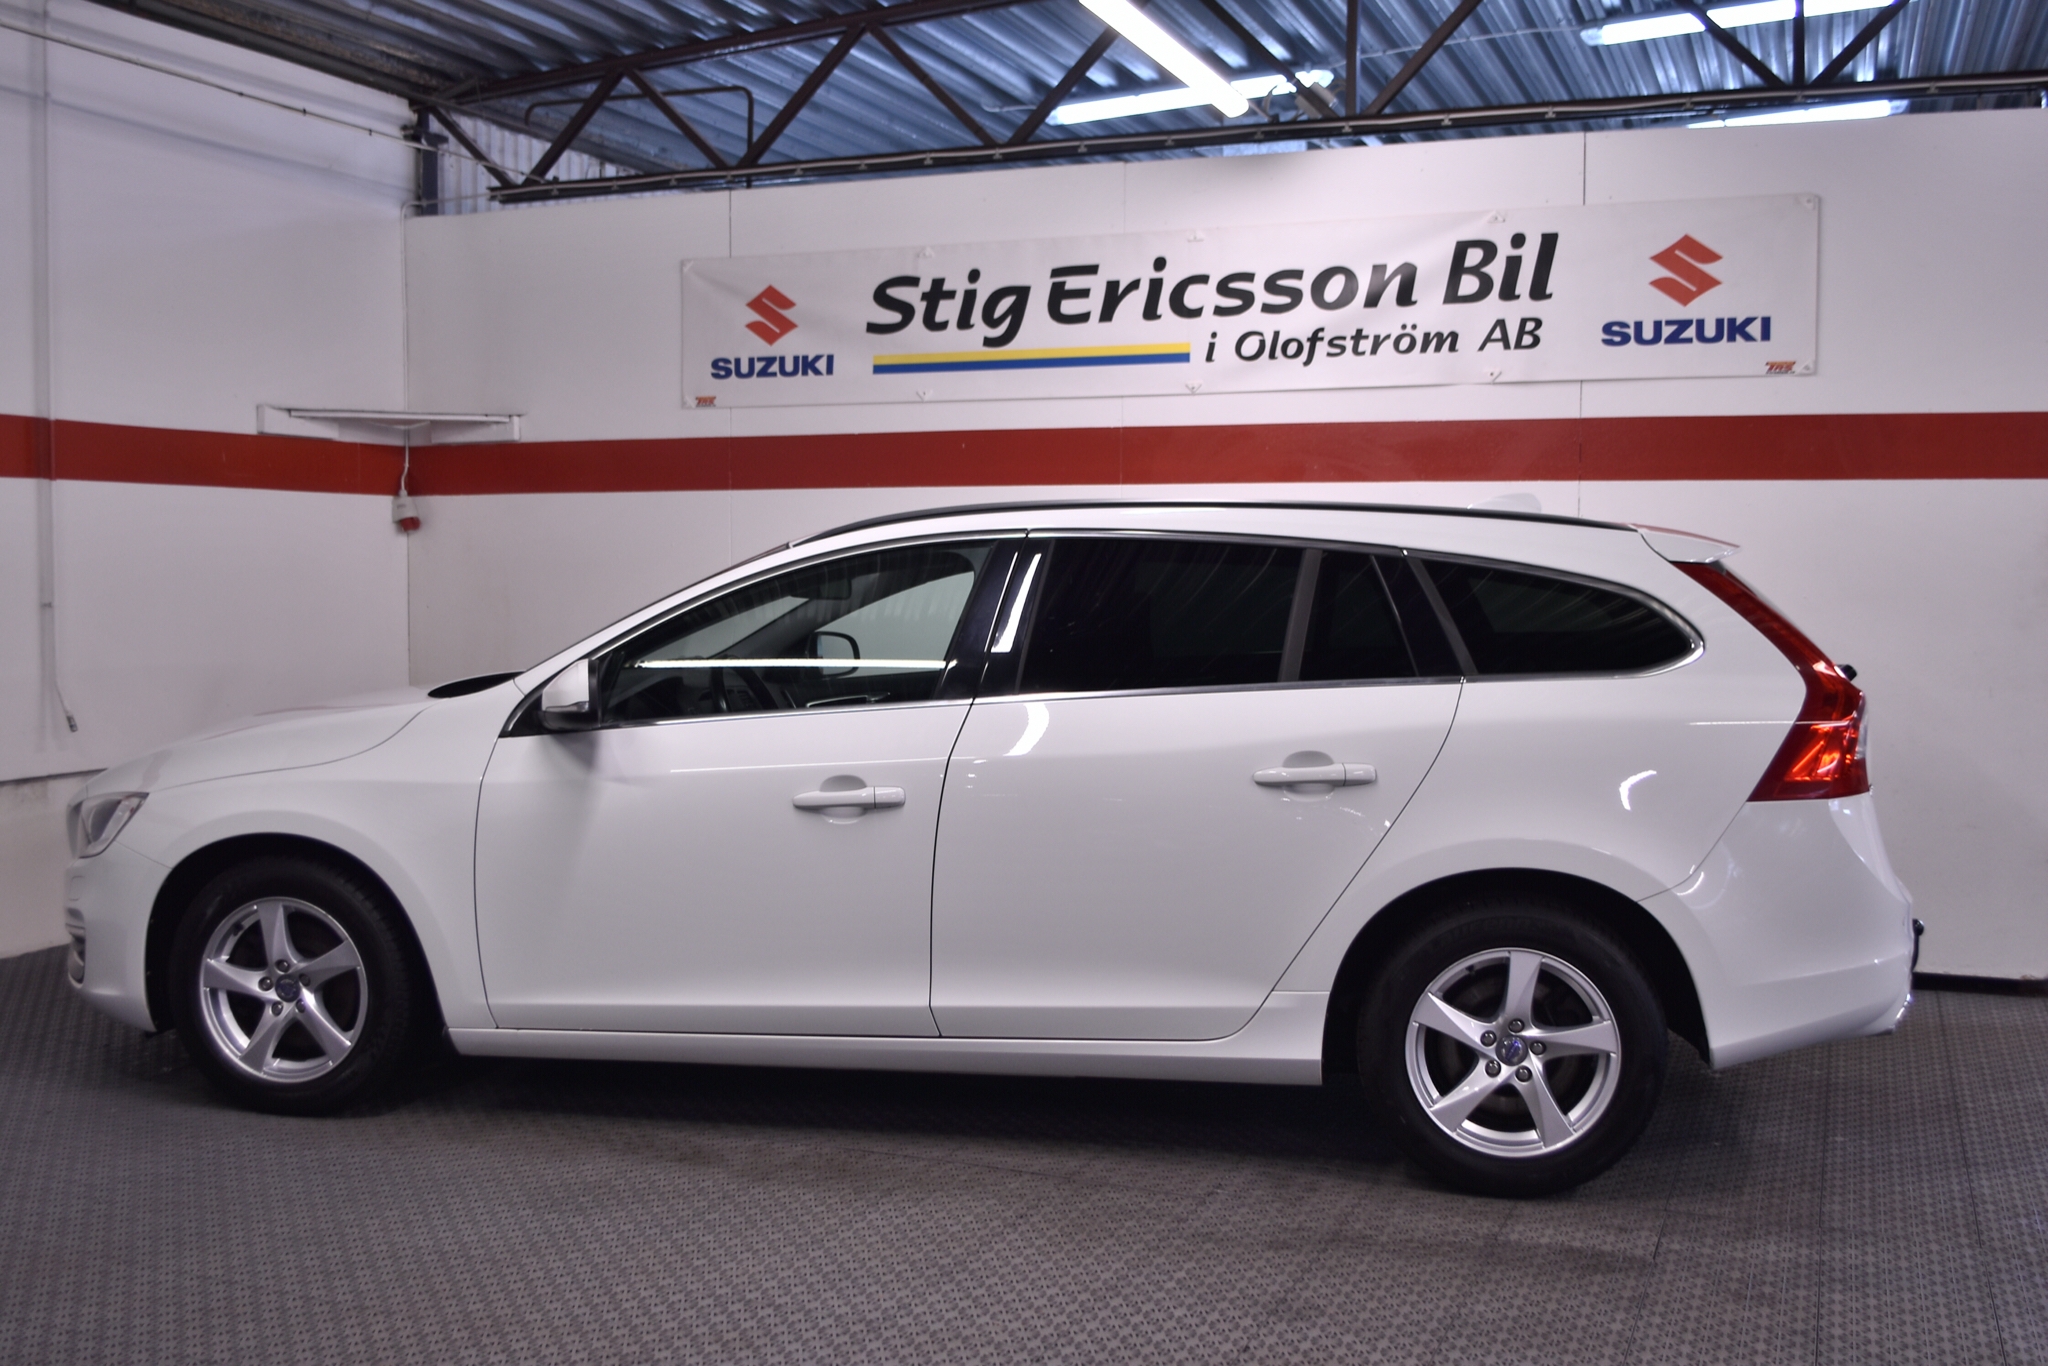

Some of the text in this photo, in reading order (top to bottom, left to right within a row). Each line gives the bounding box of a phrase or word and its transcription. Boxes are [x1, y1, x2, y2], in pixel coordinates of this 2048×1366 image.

[865, 231, 1560, 348] Stig Ericsson Bil
[1205, 316, 1543, 367] i Olofström AB
[1601, 315, 1772, 347] SUZUKI
[710, 353, 835, 380] SUZUKI
